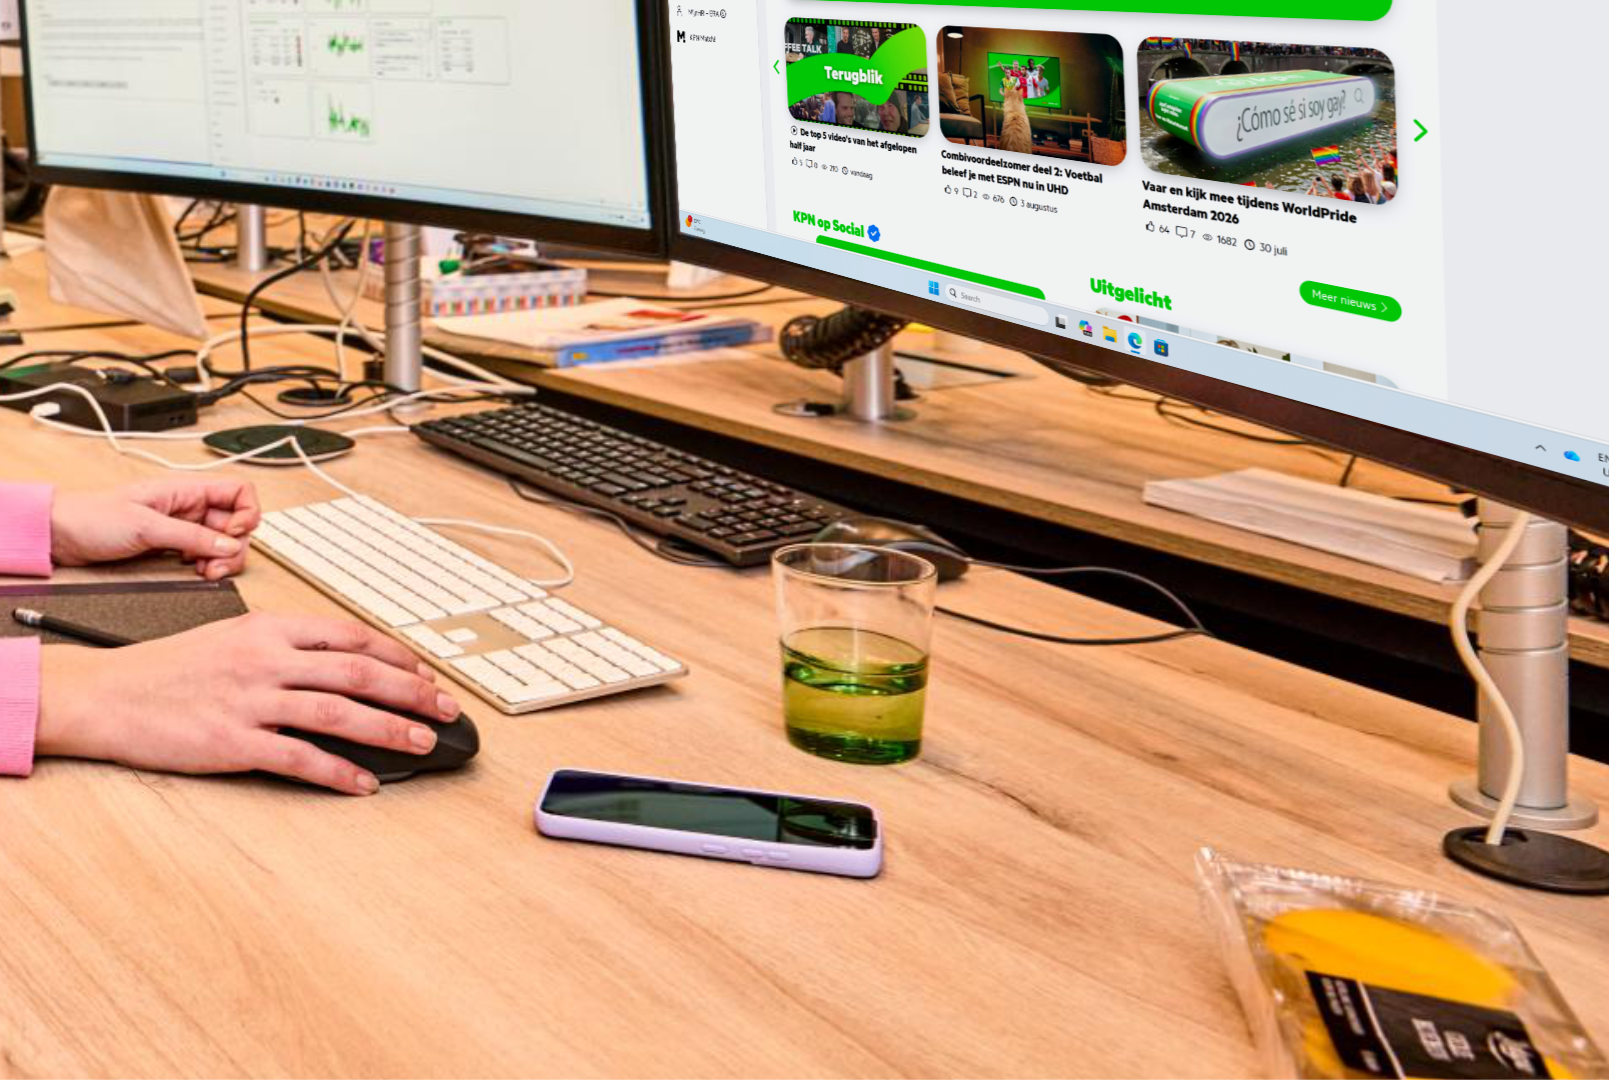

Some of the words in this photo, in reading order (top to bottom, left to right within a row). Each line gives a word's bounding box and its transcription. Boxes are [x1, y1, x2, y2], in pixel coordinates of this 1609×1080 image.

[801, 43, 822, 54] TALK
[824, 65, 884, 85] Terugblik
[1236, 105, 1281, 142] ¿Cómo
[1283, 99, 1297, 123] sé
[1298, 98, 1307, 120] si
[1308, 100, 1324, 121] soy
[1326, 89, 1347, 117] gay?
[789, 140, 802, 150] half
[802, 142, 816, 152] jaar
[800, 128, 809, 137] De
[810, 130, 822, 140] top
[822, 131, 827, 140] 5
[828, 132, 852, 144] video's
[852, 137, 865, 146] van
[866, 138, 879, 148] het
[880, 141, 917, 154] afgelopen
[850, 169, 873, 180] vandaag
[941, 149, 1031, 172] Combivoordeelzomer
[1032, 163, 1052, 176] deel
[1053, 167, 1063, 177] 2:
[1064, 168, 1103, 184] Voetbal
[942, 165, 967, 178] beleef
[968, 169, 976, 181] je
[977, 172, 995, 183] met
[996, 174, 1021, 187] ESPN
[1022, 180, 1034, 190] nu
[1035, 180, 1045, 191] in
[1046, 183, 1069, 195] UHD
[954, 187, 959, 195] 9
[1020, 199, 1025, 207] 3
[1026, 201, 1058, 213] augustus
[1142, 180, 1167, 194] Vaar
[1169, 184, 1183, 197] en
[1185, 184, 1207, 200] kijk
[1209, 192, 1234, 204] mee
[1236, 194, 1279, 211] tijdens
[1282, 201, 1357, 224] WorldPride
[1142, 199, 1208, 219] Amsterdam
[1210, 209, 1239, 225] 2026
[792, 210, 816, 226] KPN
[817, 219, 831, 232] op
[832, 219, 865, 238] Social
[1158, 225, 1170, 235] 64
[1190, 230, 1196, 239] 7
[1217, 235, 1238, 247] 1682
[1259, 242, 1272, 253] 30
[1273, 245, 1288, 257] juli
[960, 291, 981, 304] Search
[1090, 277, 1173, 311] Uitgelicht
[1312, 289, 1338, 302] Meer
[1340, 296, 1377, 311] nieuws
